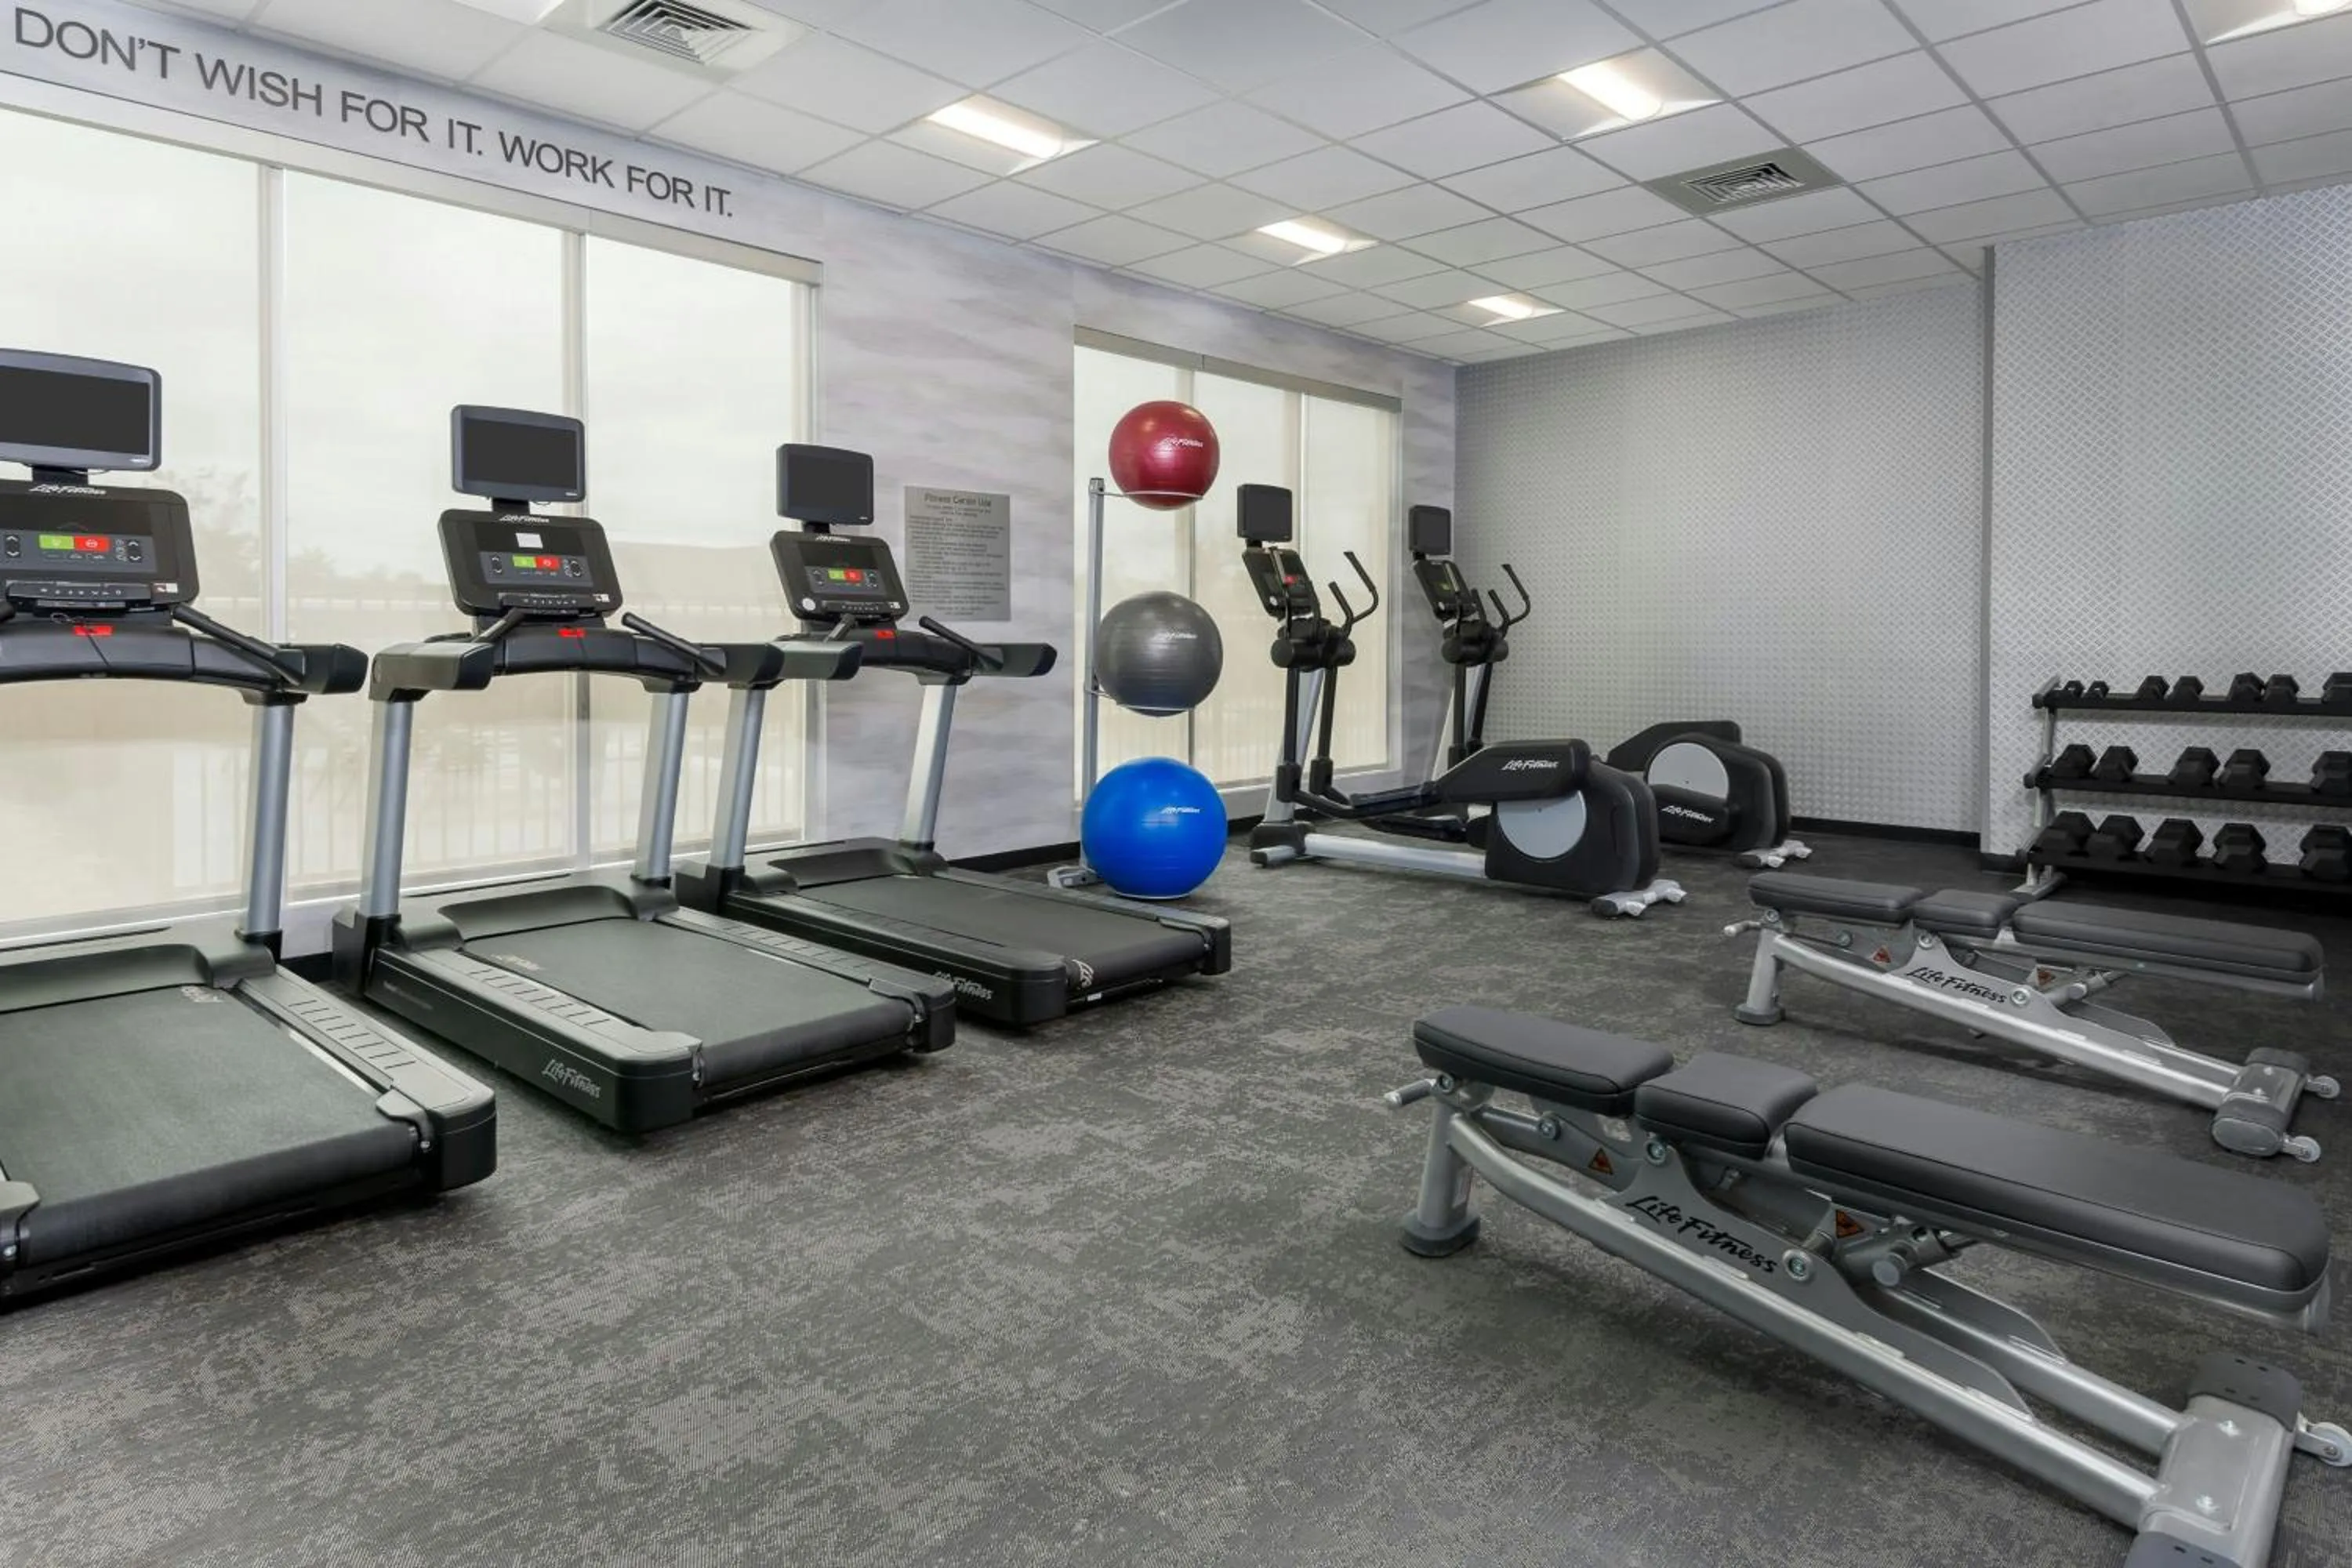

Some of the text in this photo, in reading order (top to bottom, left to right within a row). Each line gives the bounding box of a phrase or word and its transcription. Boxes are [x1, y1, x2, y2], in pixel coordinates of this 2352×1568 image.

[16, 8, 732, 217] DON'T WISH FOR IT. WORK FOR IT.
